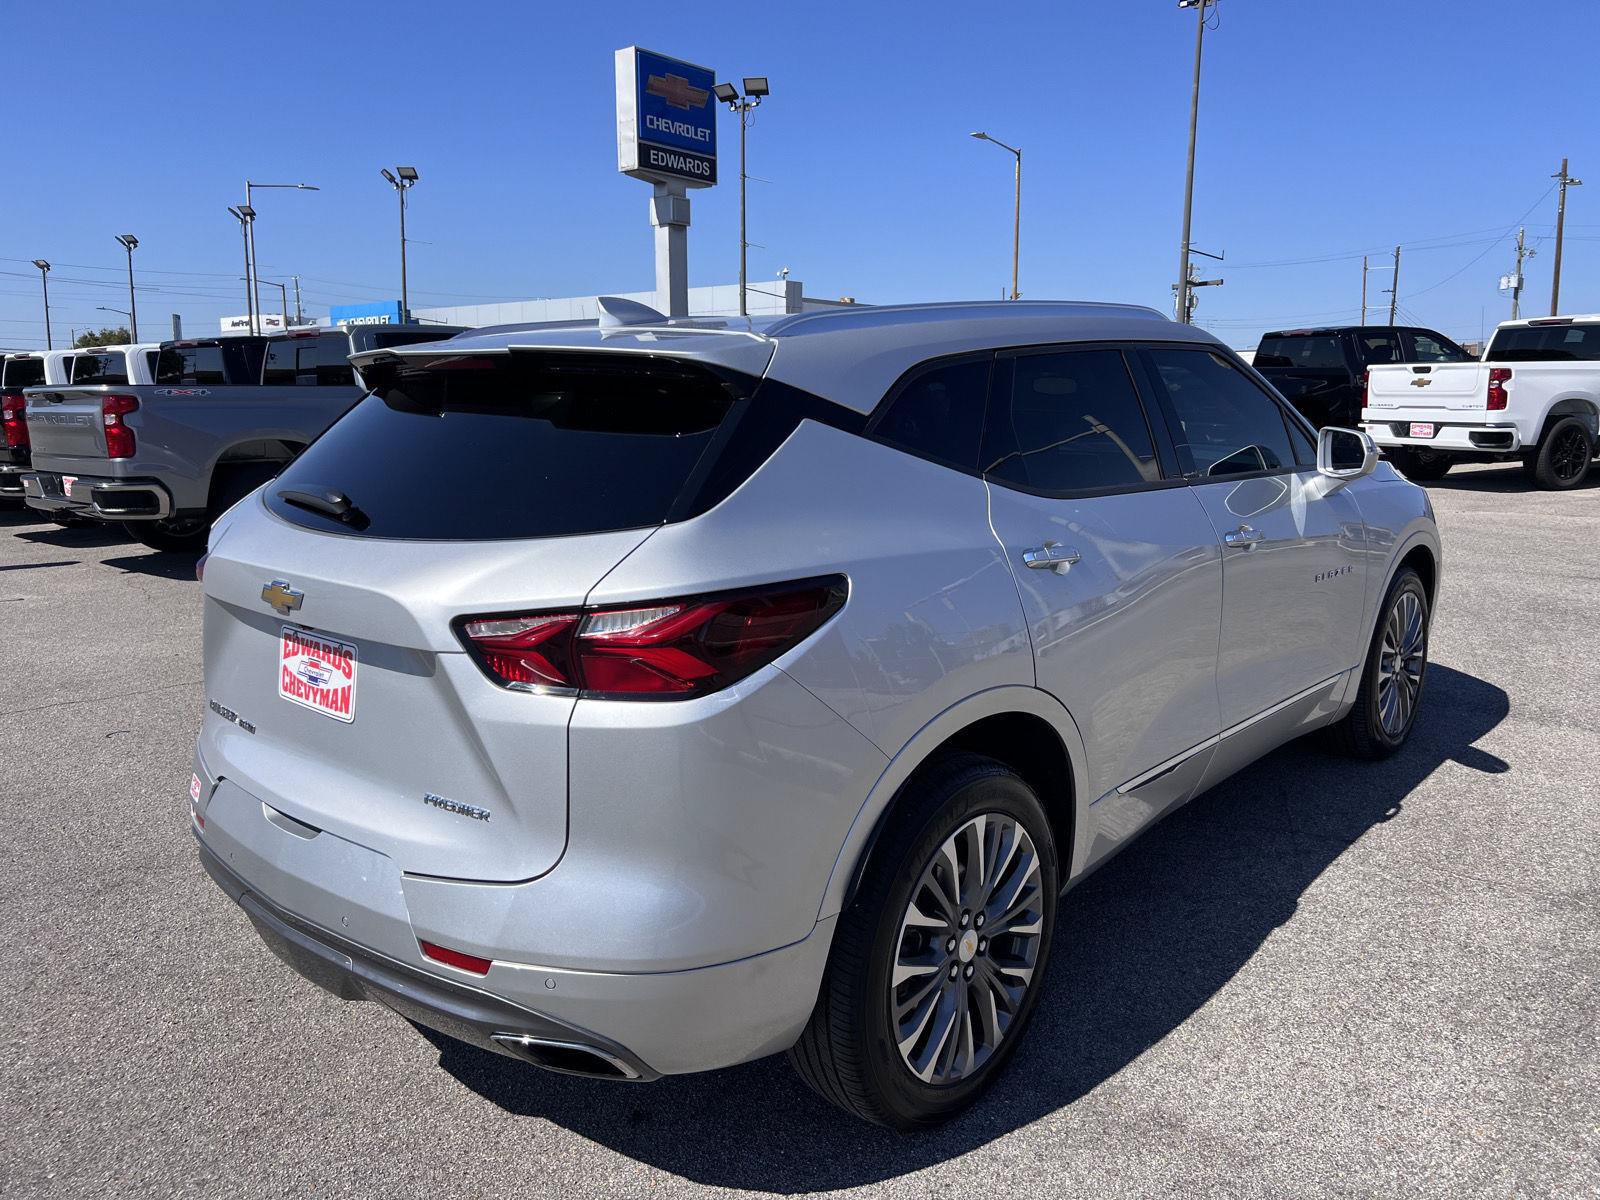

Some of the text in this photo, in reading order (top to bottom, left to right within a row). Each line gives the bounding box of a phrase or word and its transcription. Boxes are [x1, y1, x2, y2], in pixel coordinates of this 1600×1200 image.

[646, 114, 710, 142] CHEVROLET
[650, 150, 710, 176] EDWARDS
[1314, 565, 1353, 583] BLAZER
[283, 632, 353, 680] EDWARDS
[282, 663, 351, 715] CHEVYMAN
[424, 792, 490, 822] PREMIER
